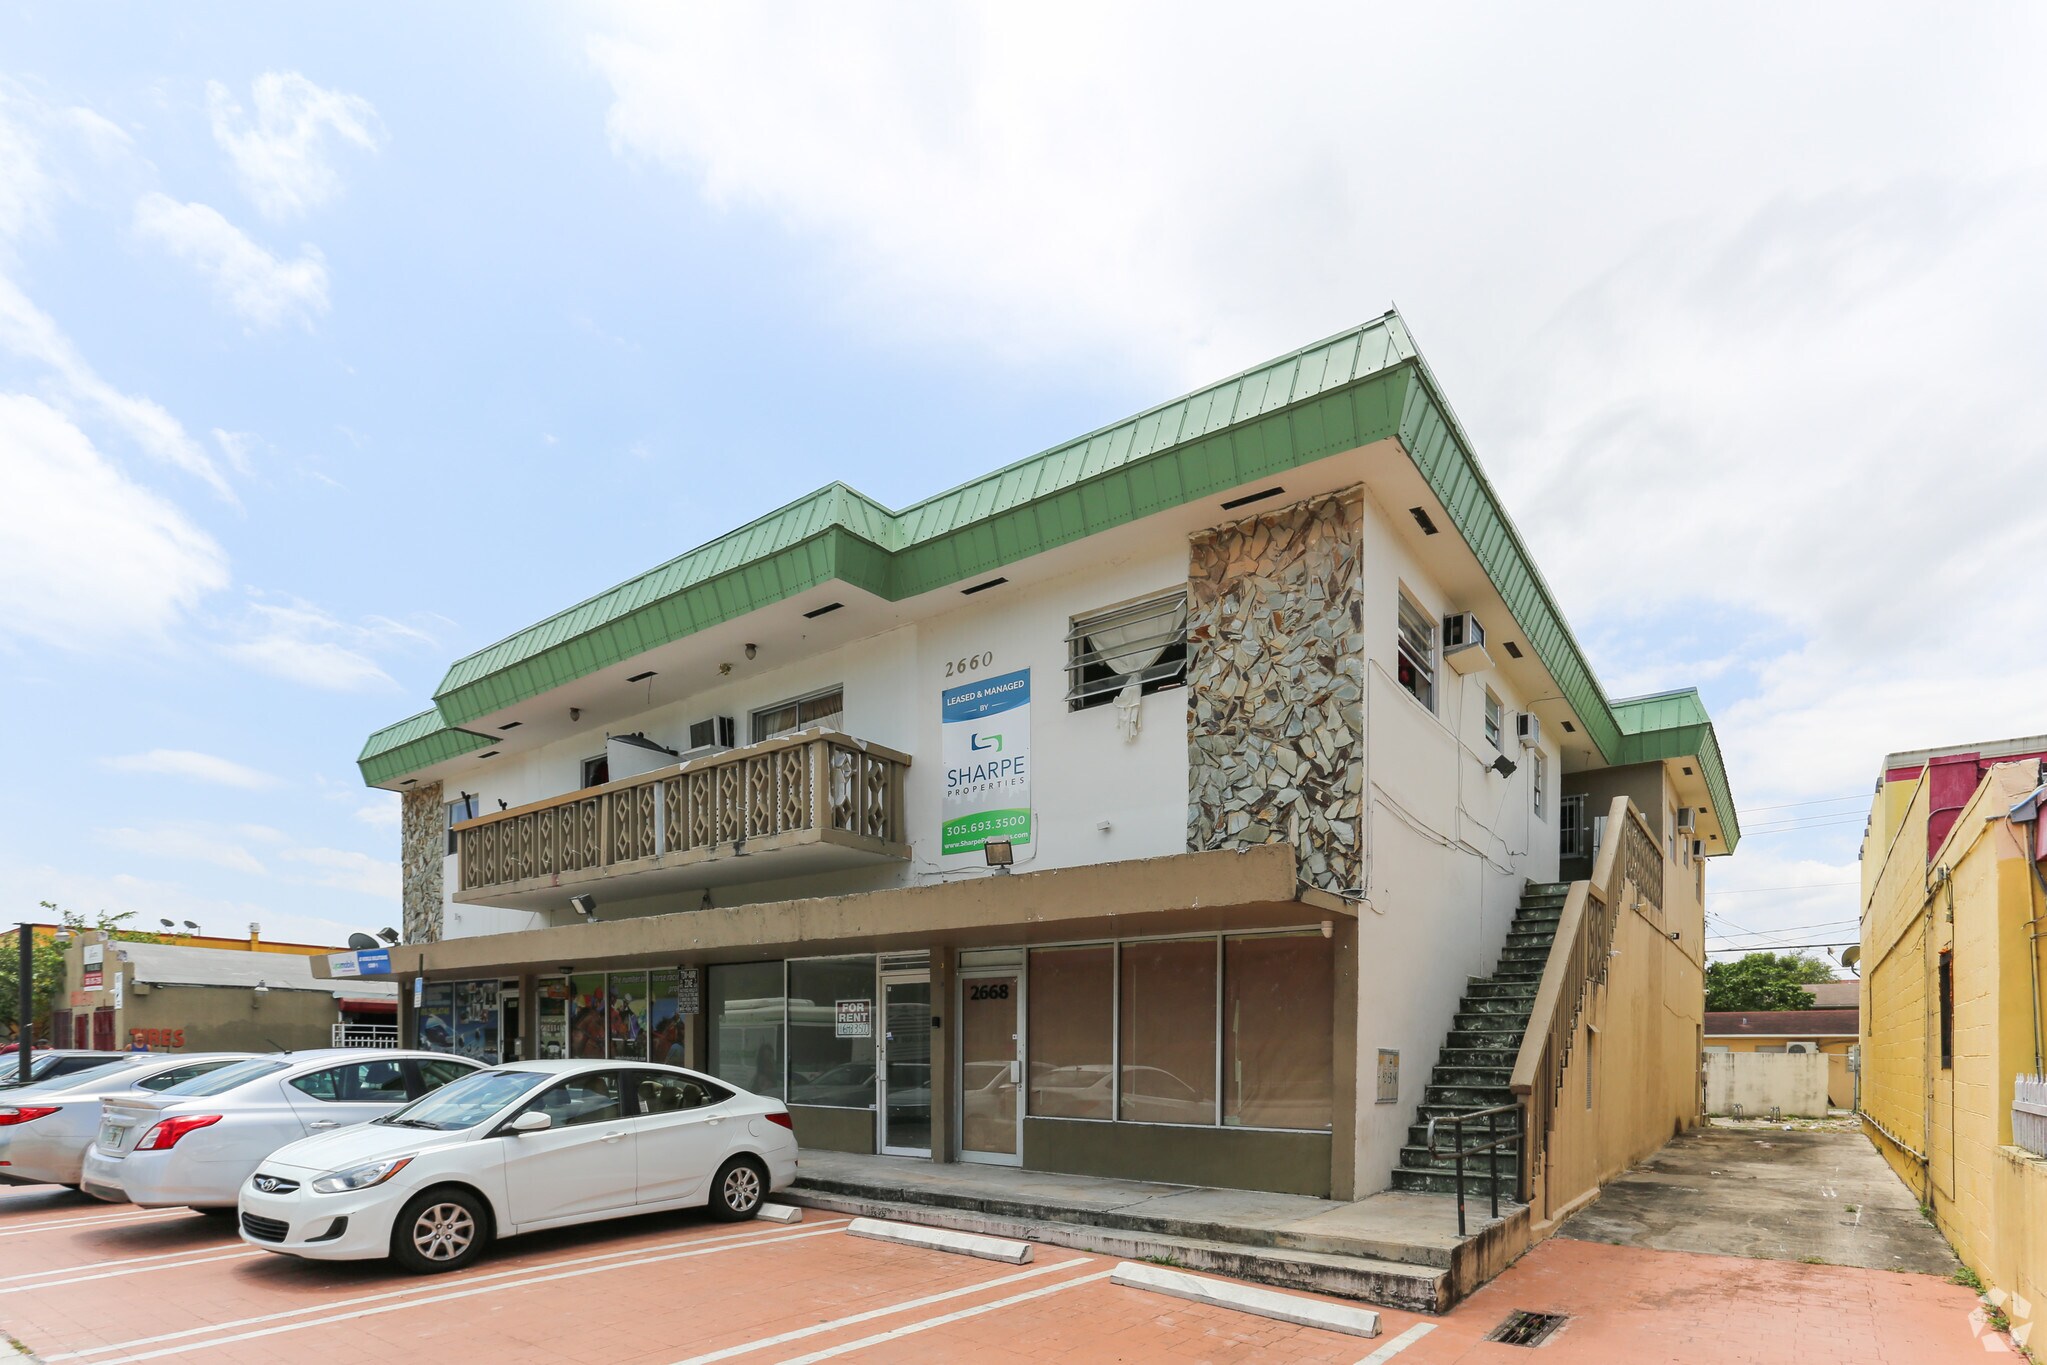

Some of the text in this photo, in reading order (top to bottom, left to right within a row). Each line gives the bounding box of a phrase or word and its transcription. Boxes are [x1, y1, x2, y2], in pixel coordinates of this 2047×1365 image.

[945, 651, 993, 678] 2660
[947, 679, 1025, 706] LEASED & MANAGED
[979, 704, 989, 712] BY
[947, 755, 1025, 788] SHARPE
[947, 776, 1025, 798] PROPERTIES
[946, 815, 1026, 837] 305.693.3500
[970, 984, 1009, 1000] 2668
[838, 1012, 868, 1023] RENT
[842, 1002, 865, 1013] FOR
